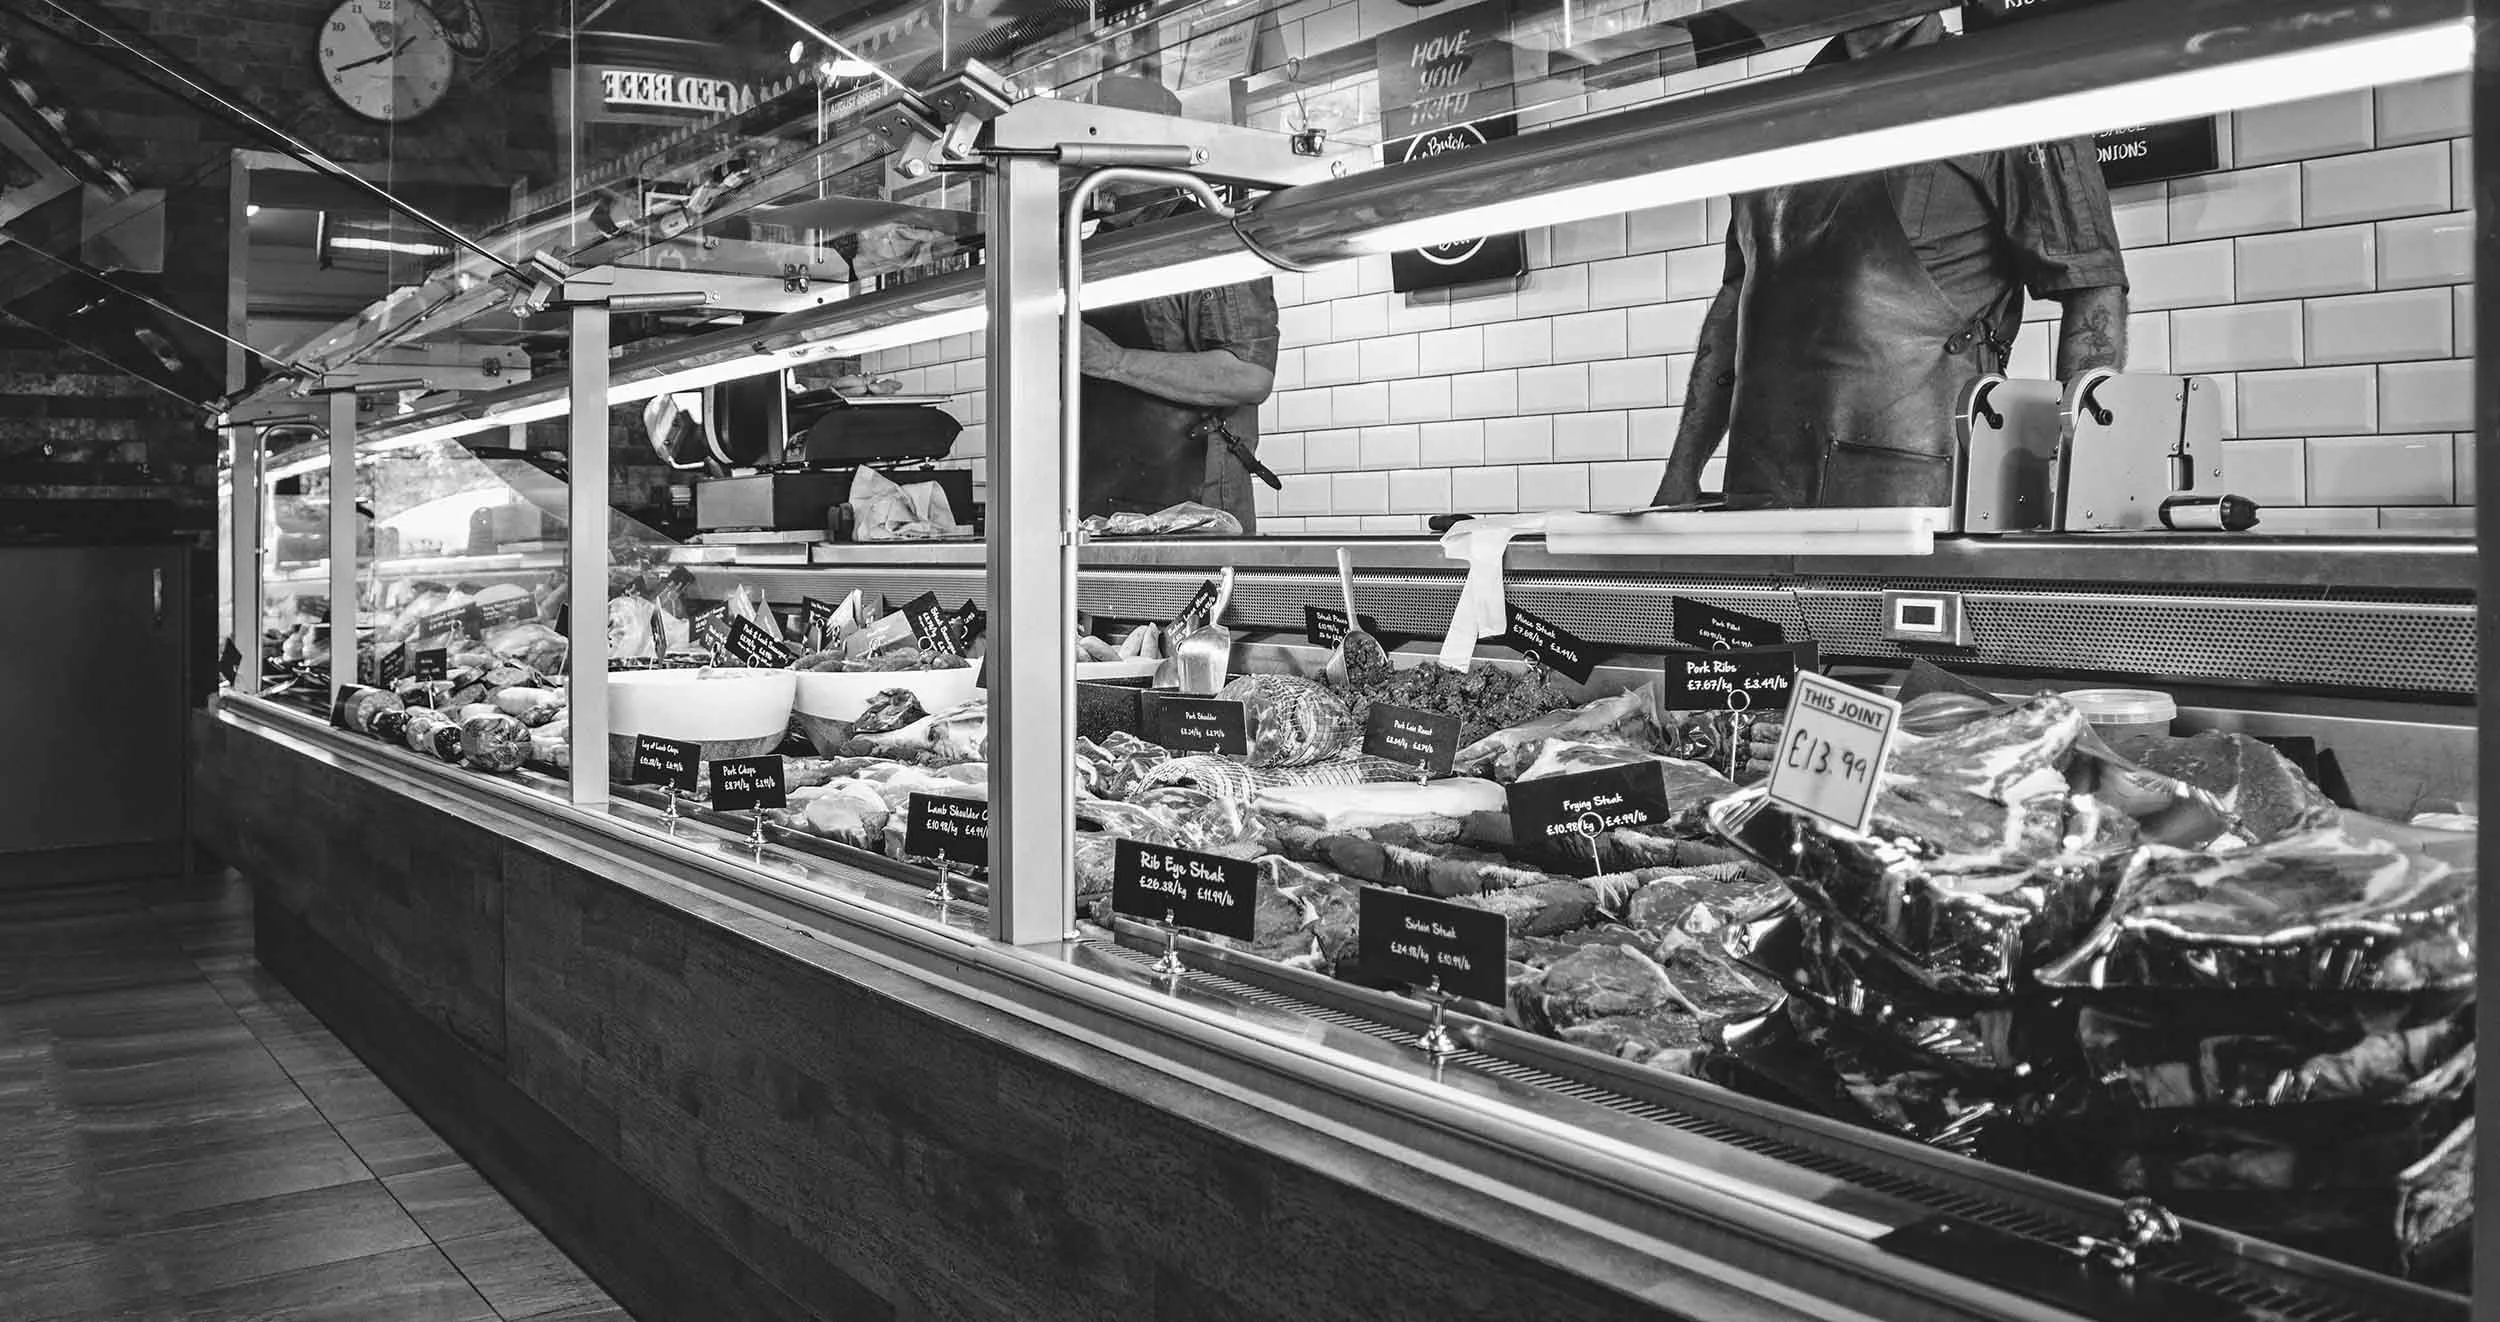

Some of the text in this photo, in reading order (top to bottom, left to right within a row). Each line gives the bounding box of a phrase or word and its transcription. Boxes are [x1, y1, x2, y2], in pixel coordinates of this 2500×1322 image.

[332, 22, 345, 32] 10
[1419, 62, 1463, 93] YOU
[1686, 660, 1737, 674] Pork Ribs
[1687, 674, 1789, 693] £7.67/kg £3.49/lb
[1805, 687, 1885, 727] THIS JOINT
[722, 764, 737, 777] Pork
[927, 800, 948, 815] Lamb
[949, 804, 980, 820] Shoulder
[1562, 792, 1624, 812] Frying Steak
[1140, 850, 1225, 883] Rib Eye Steak
[1139, 875, 1187, 900] £26.38/kg
[1431, 922, 1457, 938] Steak
